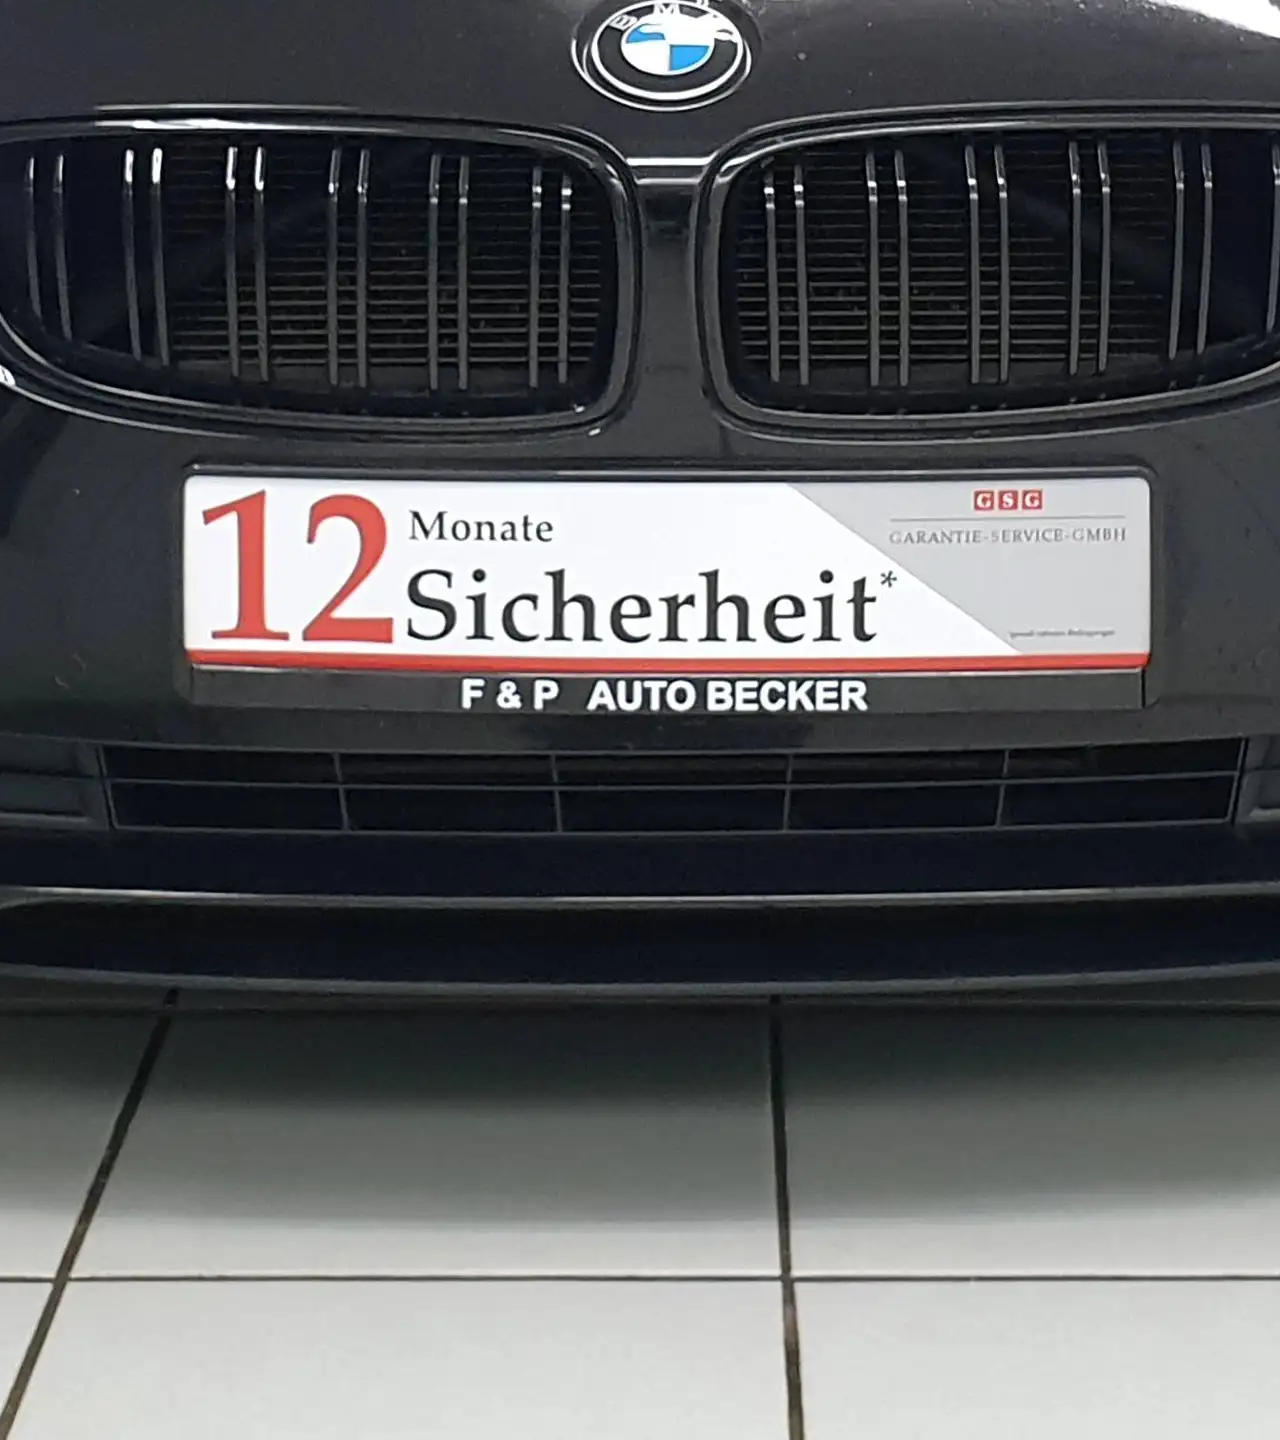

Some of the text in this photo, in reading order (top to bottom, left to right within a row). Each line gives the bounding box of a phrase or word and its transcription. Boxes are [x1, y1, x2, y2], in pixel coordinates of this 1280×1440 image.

[975, 491, 1041, 510] GSG
[408, 510, 553, 542] Monate
[202, 489, 394, 643] 12
[461, 679, 869, 712] F & P AUTO BECKER
